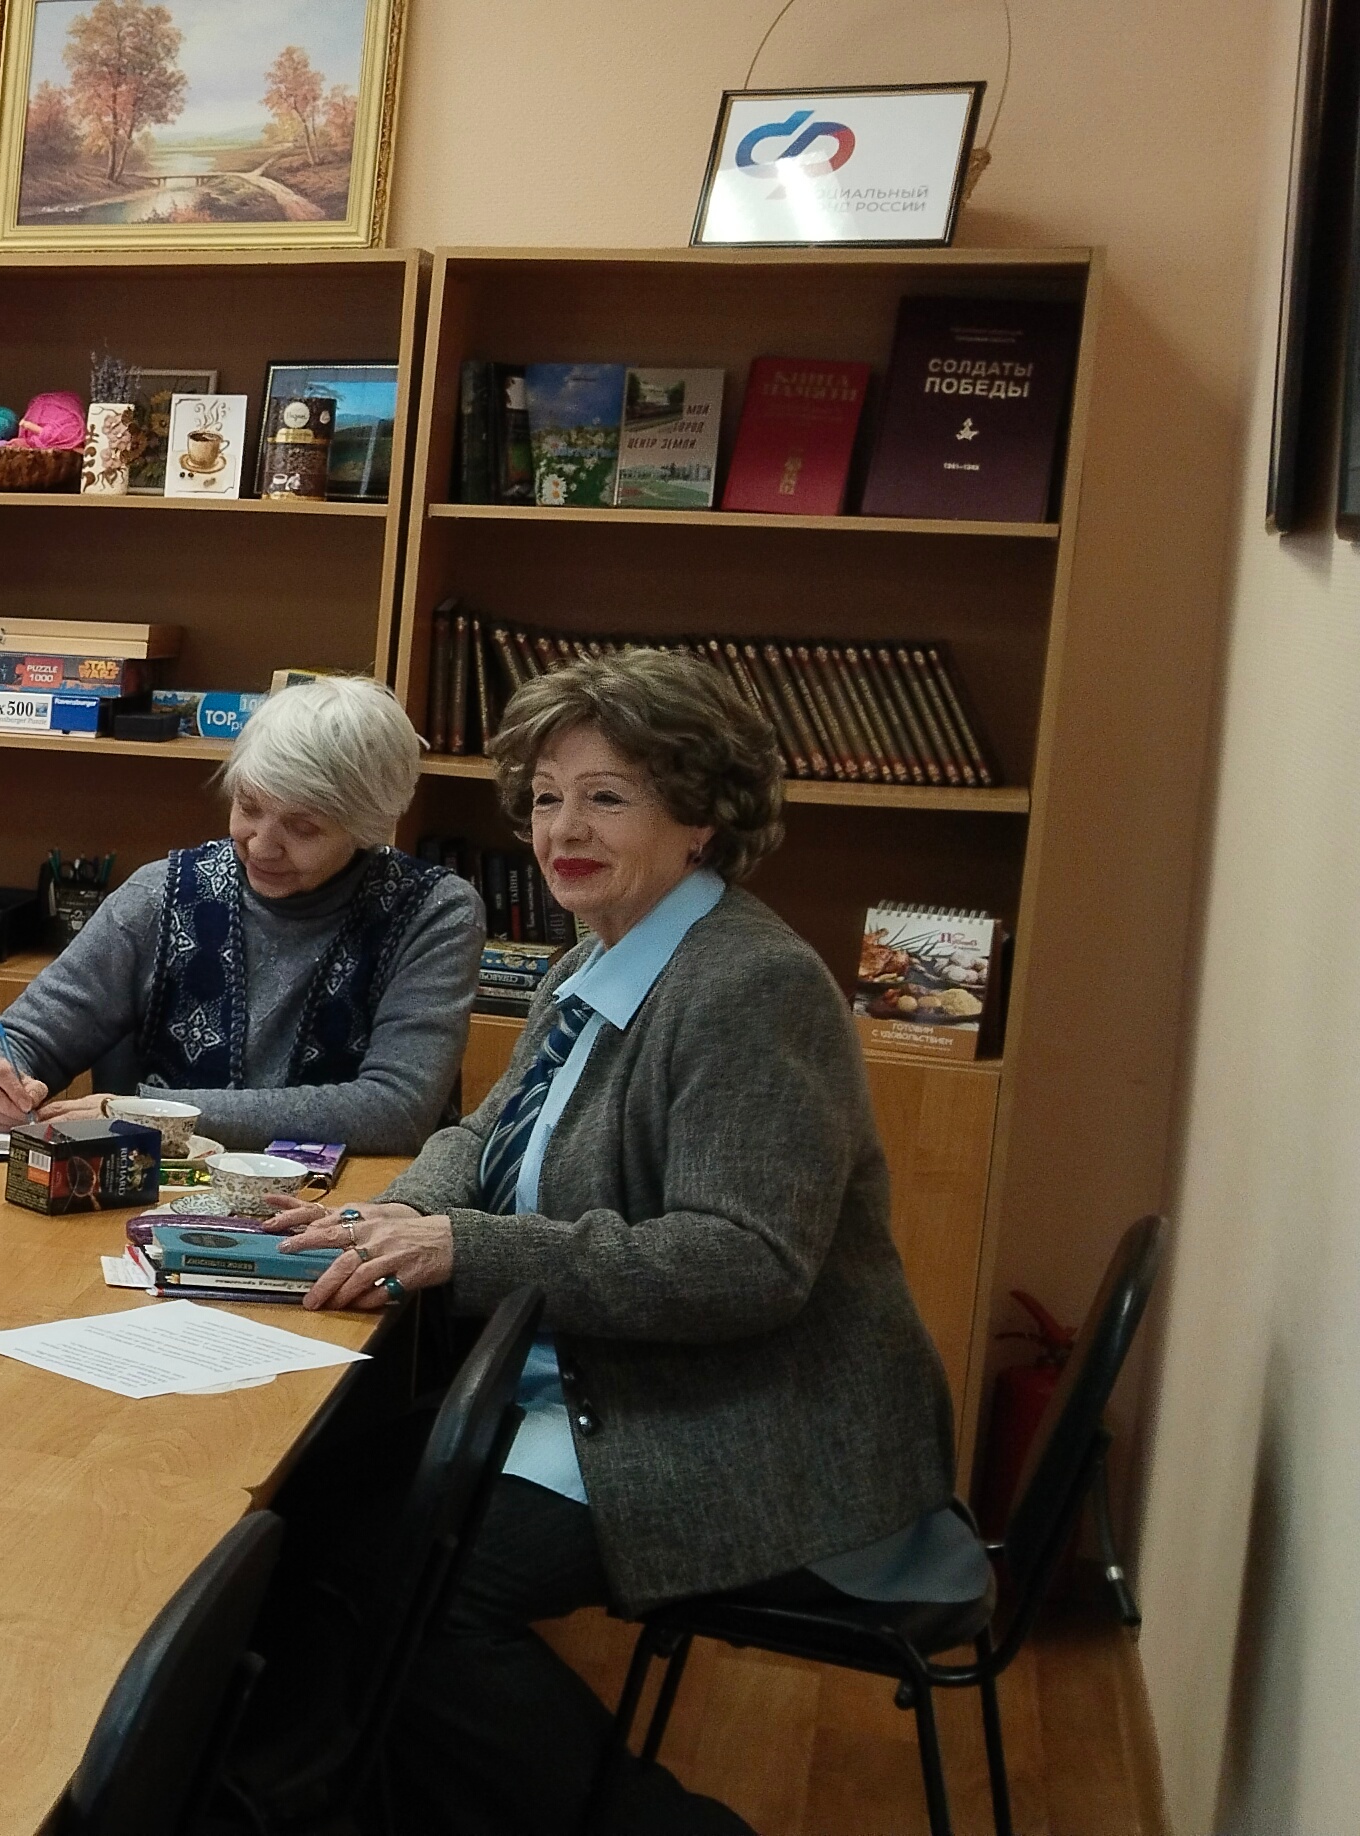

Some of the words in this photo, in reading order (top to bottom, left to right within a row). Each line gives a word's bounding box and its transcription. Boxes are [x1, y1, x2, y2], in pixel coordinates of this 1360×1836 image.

[855, 201, 927, 213] РОССИИ
[928, 357, 1034, 377] СОЛДАТЫ
[924, 377, 1030, 399] ПОБЕДЫ
[626, 437, 657, 449] ЦЕНТР
[26, 664, 59, 674] PUZZLE
[83, 660, 118, 672] STAR
[29, 673, 54, 683] 1000
[78, 668, 121, 680] WARS
[54, 697, 98, 708] Ravensburger
[205, 710, 237, 726] TOP
[118, 1147, 128, 1196] RICHARD
